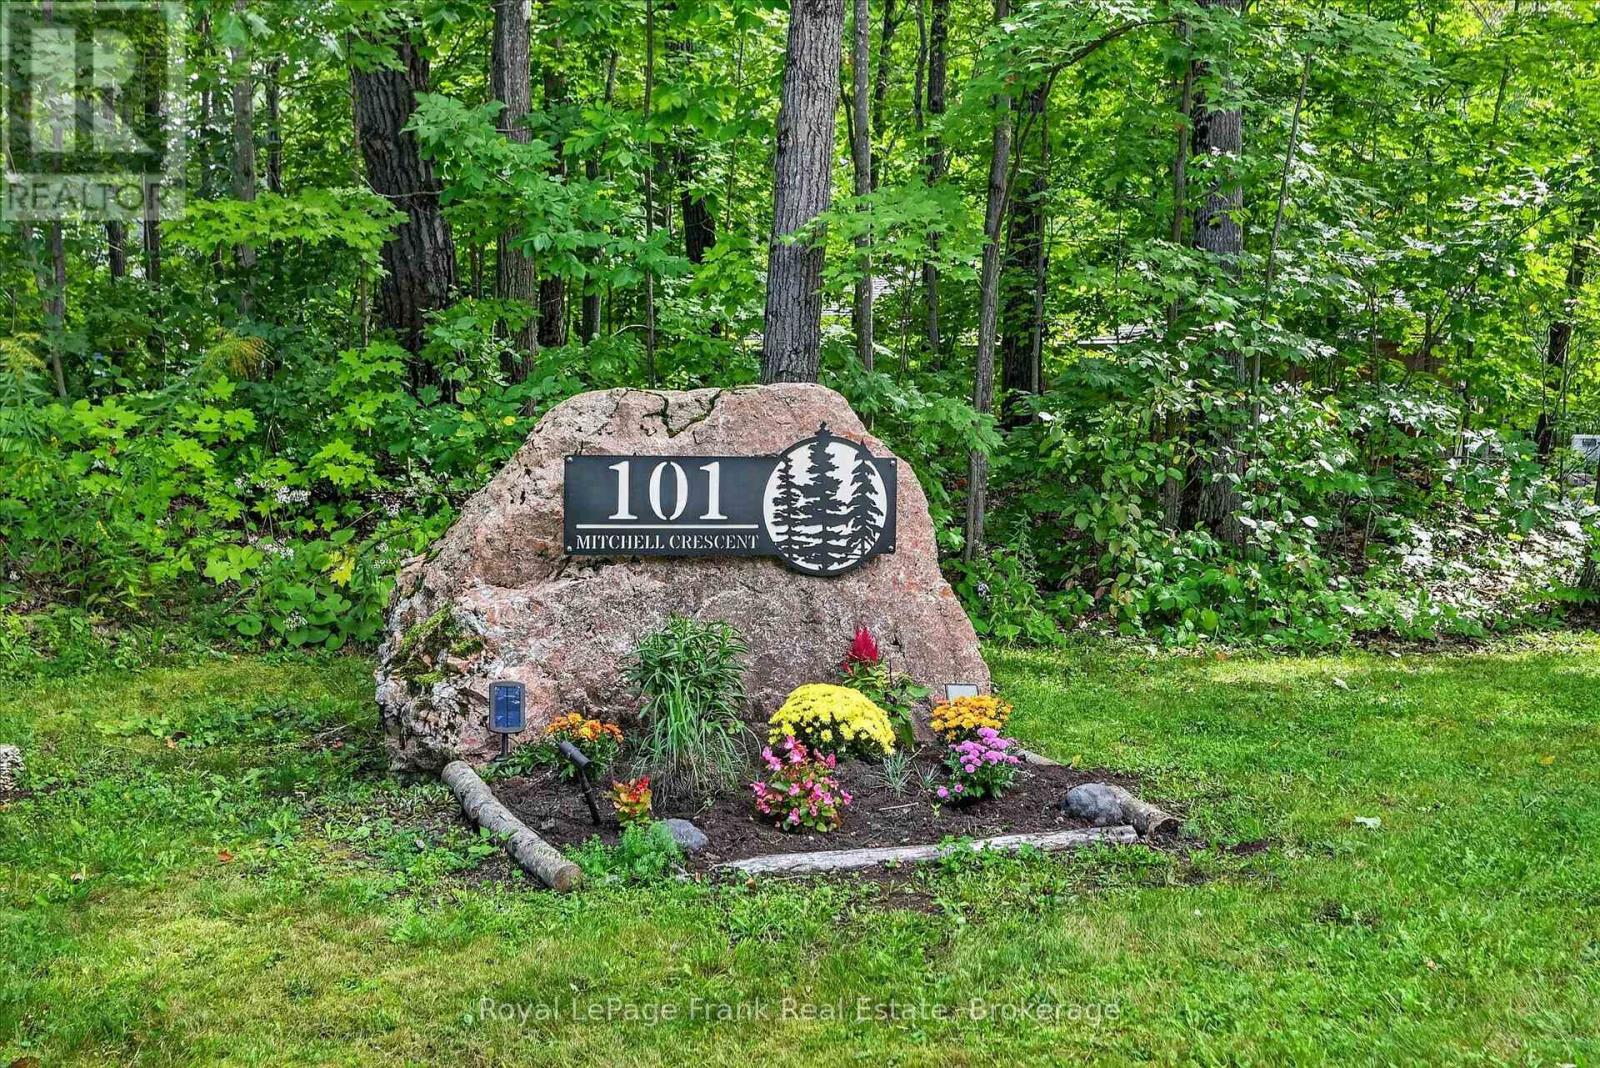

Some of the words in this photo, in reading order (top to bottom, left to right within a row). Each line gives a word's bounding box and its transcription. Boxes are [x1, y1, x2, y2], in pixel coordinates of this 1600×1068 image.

[608, 460, 728, 521] 101
[576, 534, 665, 550] MITCHELL
[669, 534, 759, 550] CRESCENT
